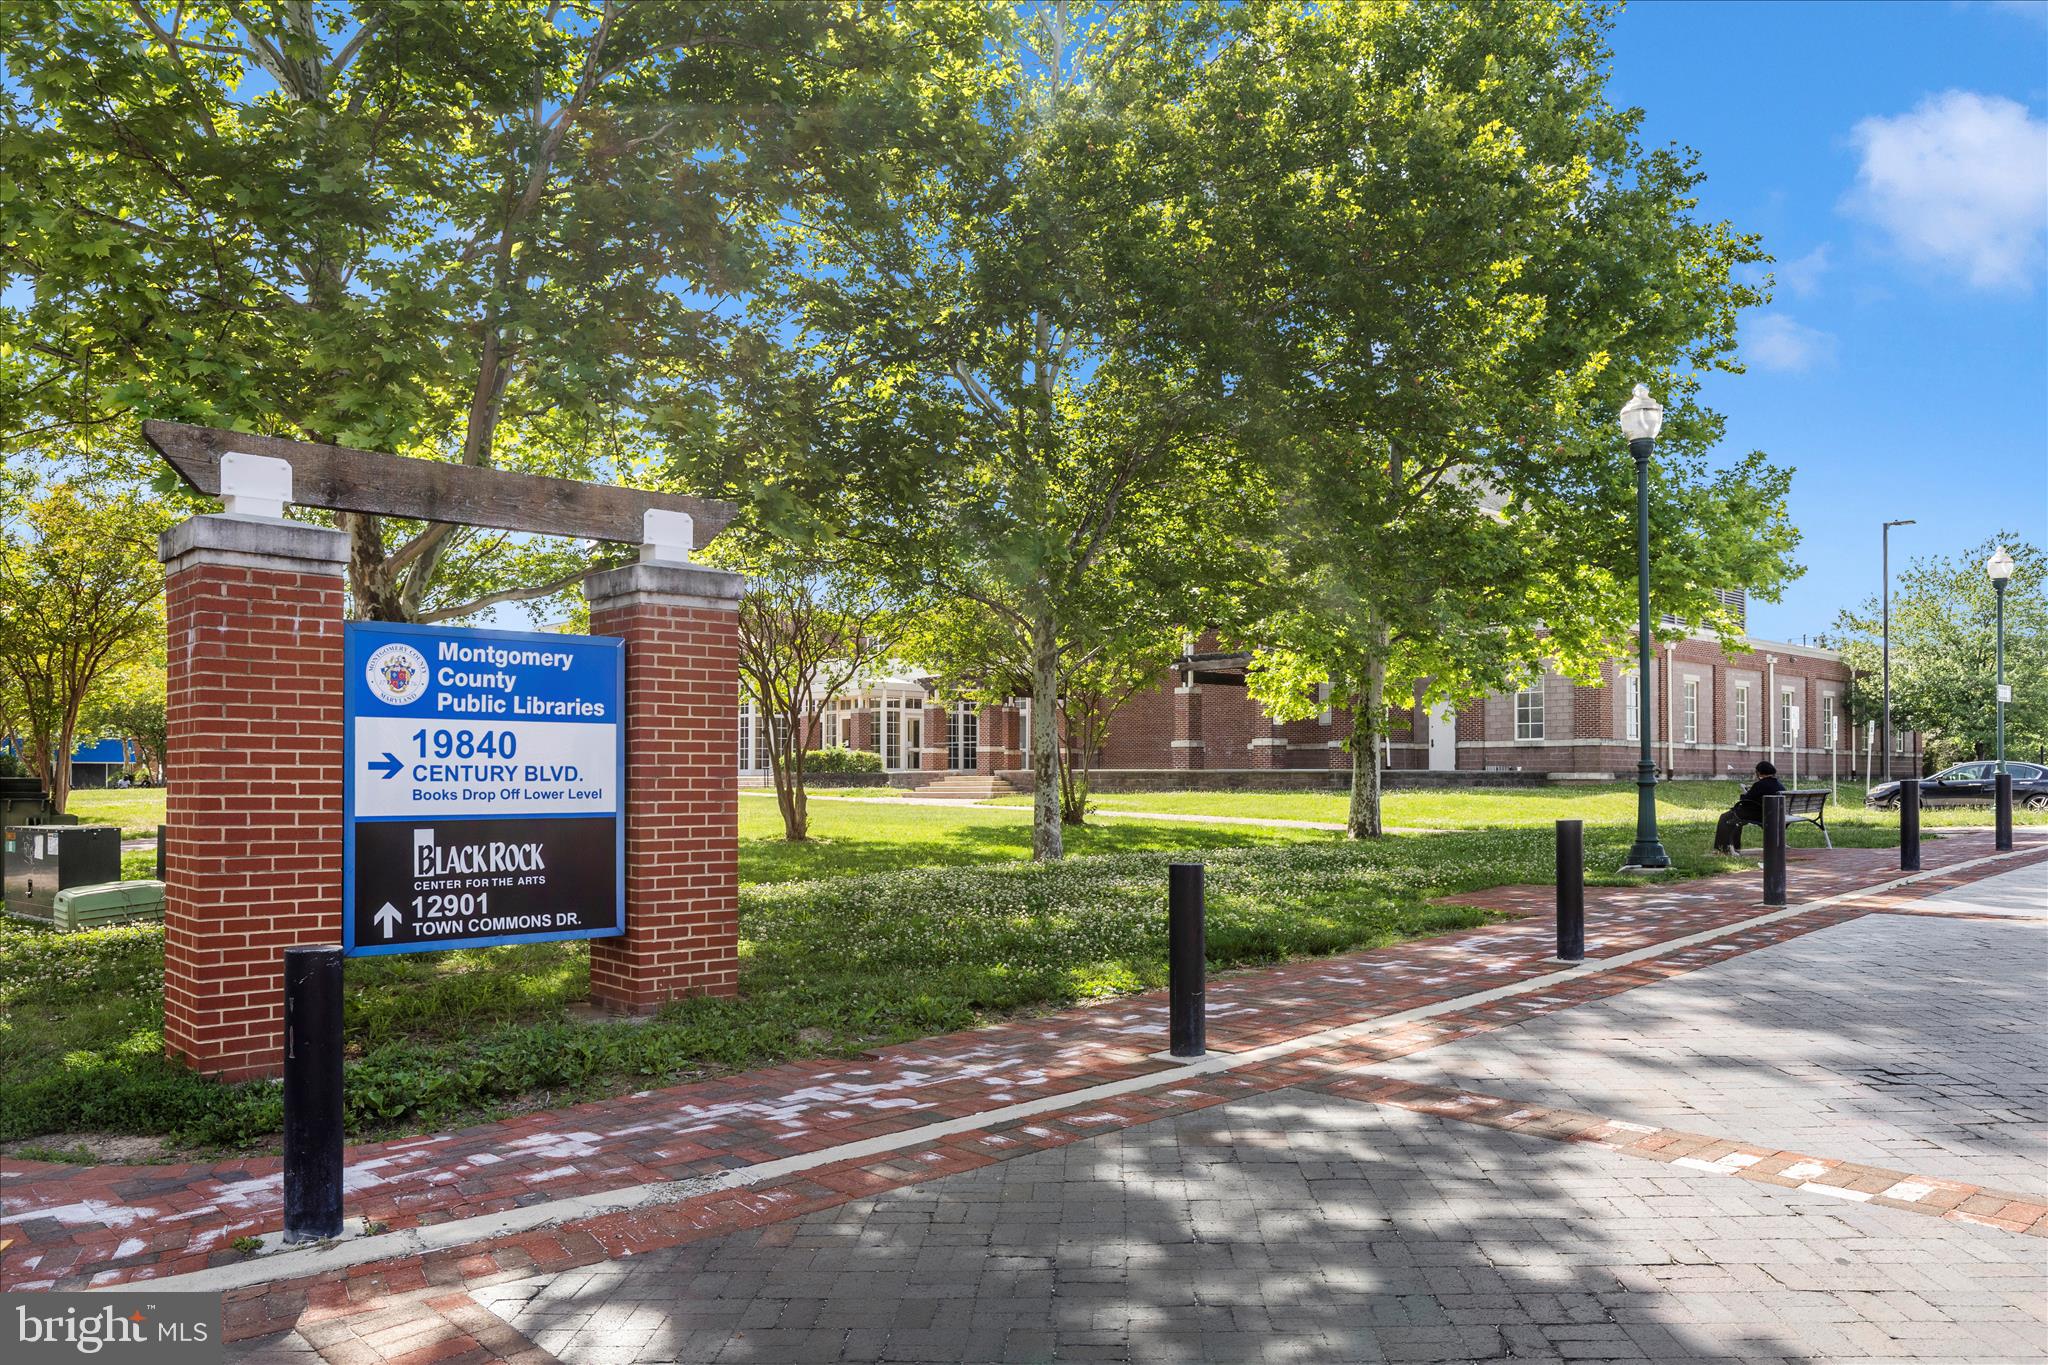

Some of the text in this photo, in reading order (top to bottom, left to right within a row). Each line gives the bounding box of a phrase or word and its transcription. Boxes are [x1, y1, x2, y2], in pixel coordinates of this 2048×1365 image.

[438, 642, 574, 671] Montgomery
[437, 667, 516, 692] County
[437, 692, 605, 717] Public Libraries
[412, 729, 517, 759] 19840
[412, 765, 584, 782] CENTURY BLVD.
[412, 788, 602, 802] Books Drop Off Lower Level
[413, 875, 546, 891] CENTER FOR THE ARTS
[411, 892, 488, 918] 12901
[412, 912, 582, 936] TOWN COMMONS DR.
